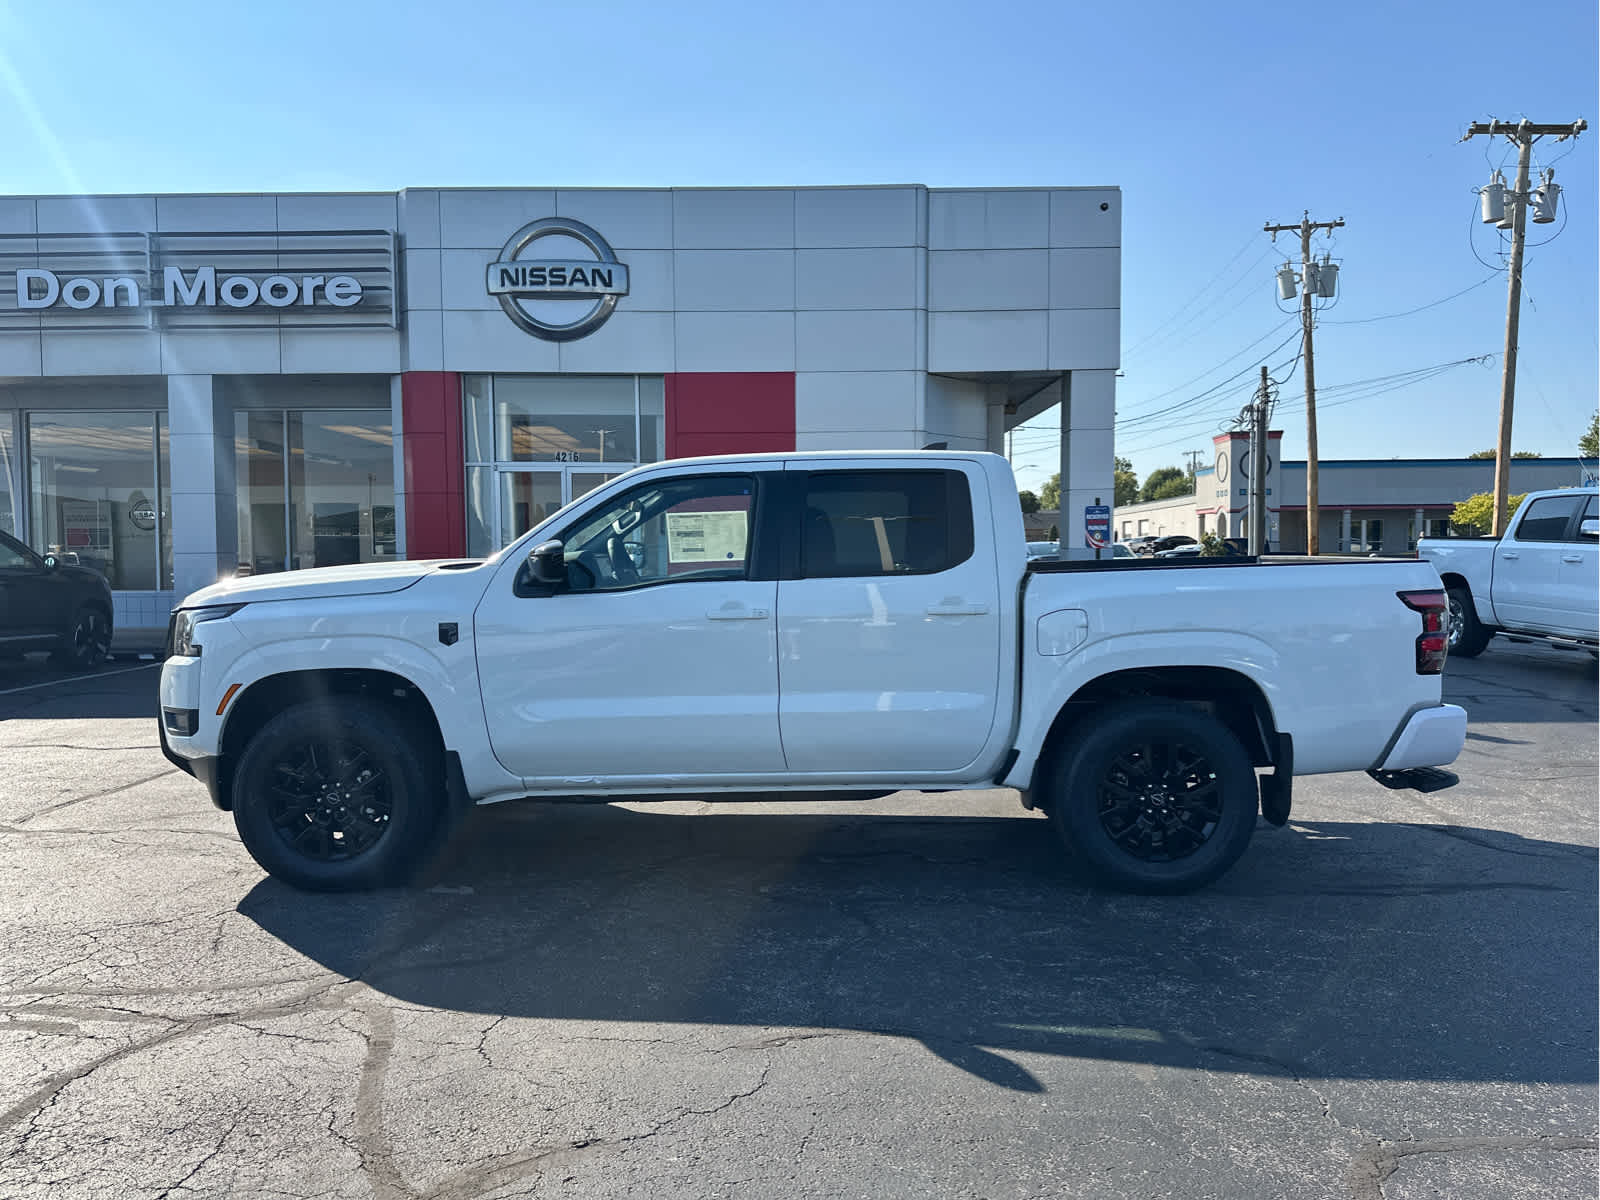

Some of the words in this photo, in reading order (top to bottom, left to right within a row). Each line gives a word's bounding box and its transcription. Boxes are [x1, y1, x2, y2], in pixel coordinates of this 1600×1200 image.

[16, 268, 141, 309] Don
[163, 265, 363, 308] Moore
[500, 266, 613, 288] NISSAN
[555, 451, 579, 462] 4216
